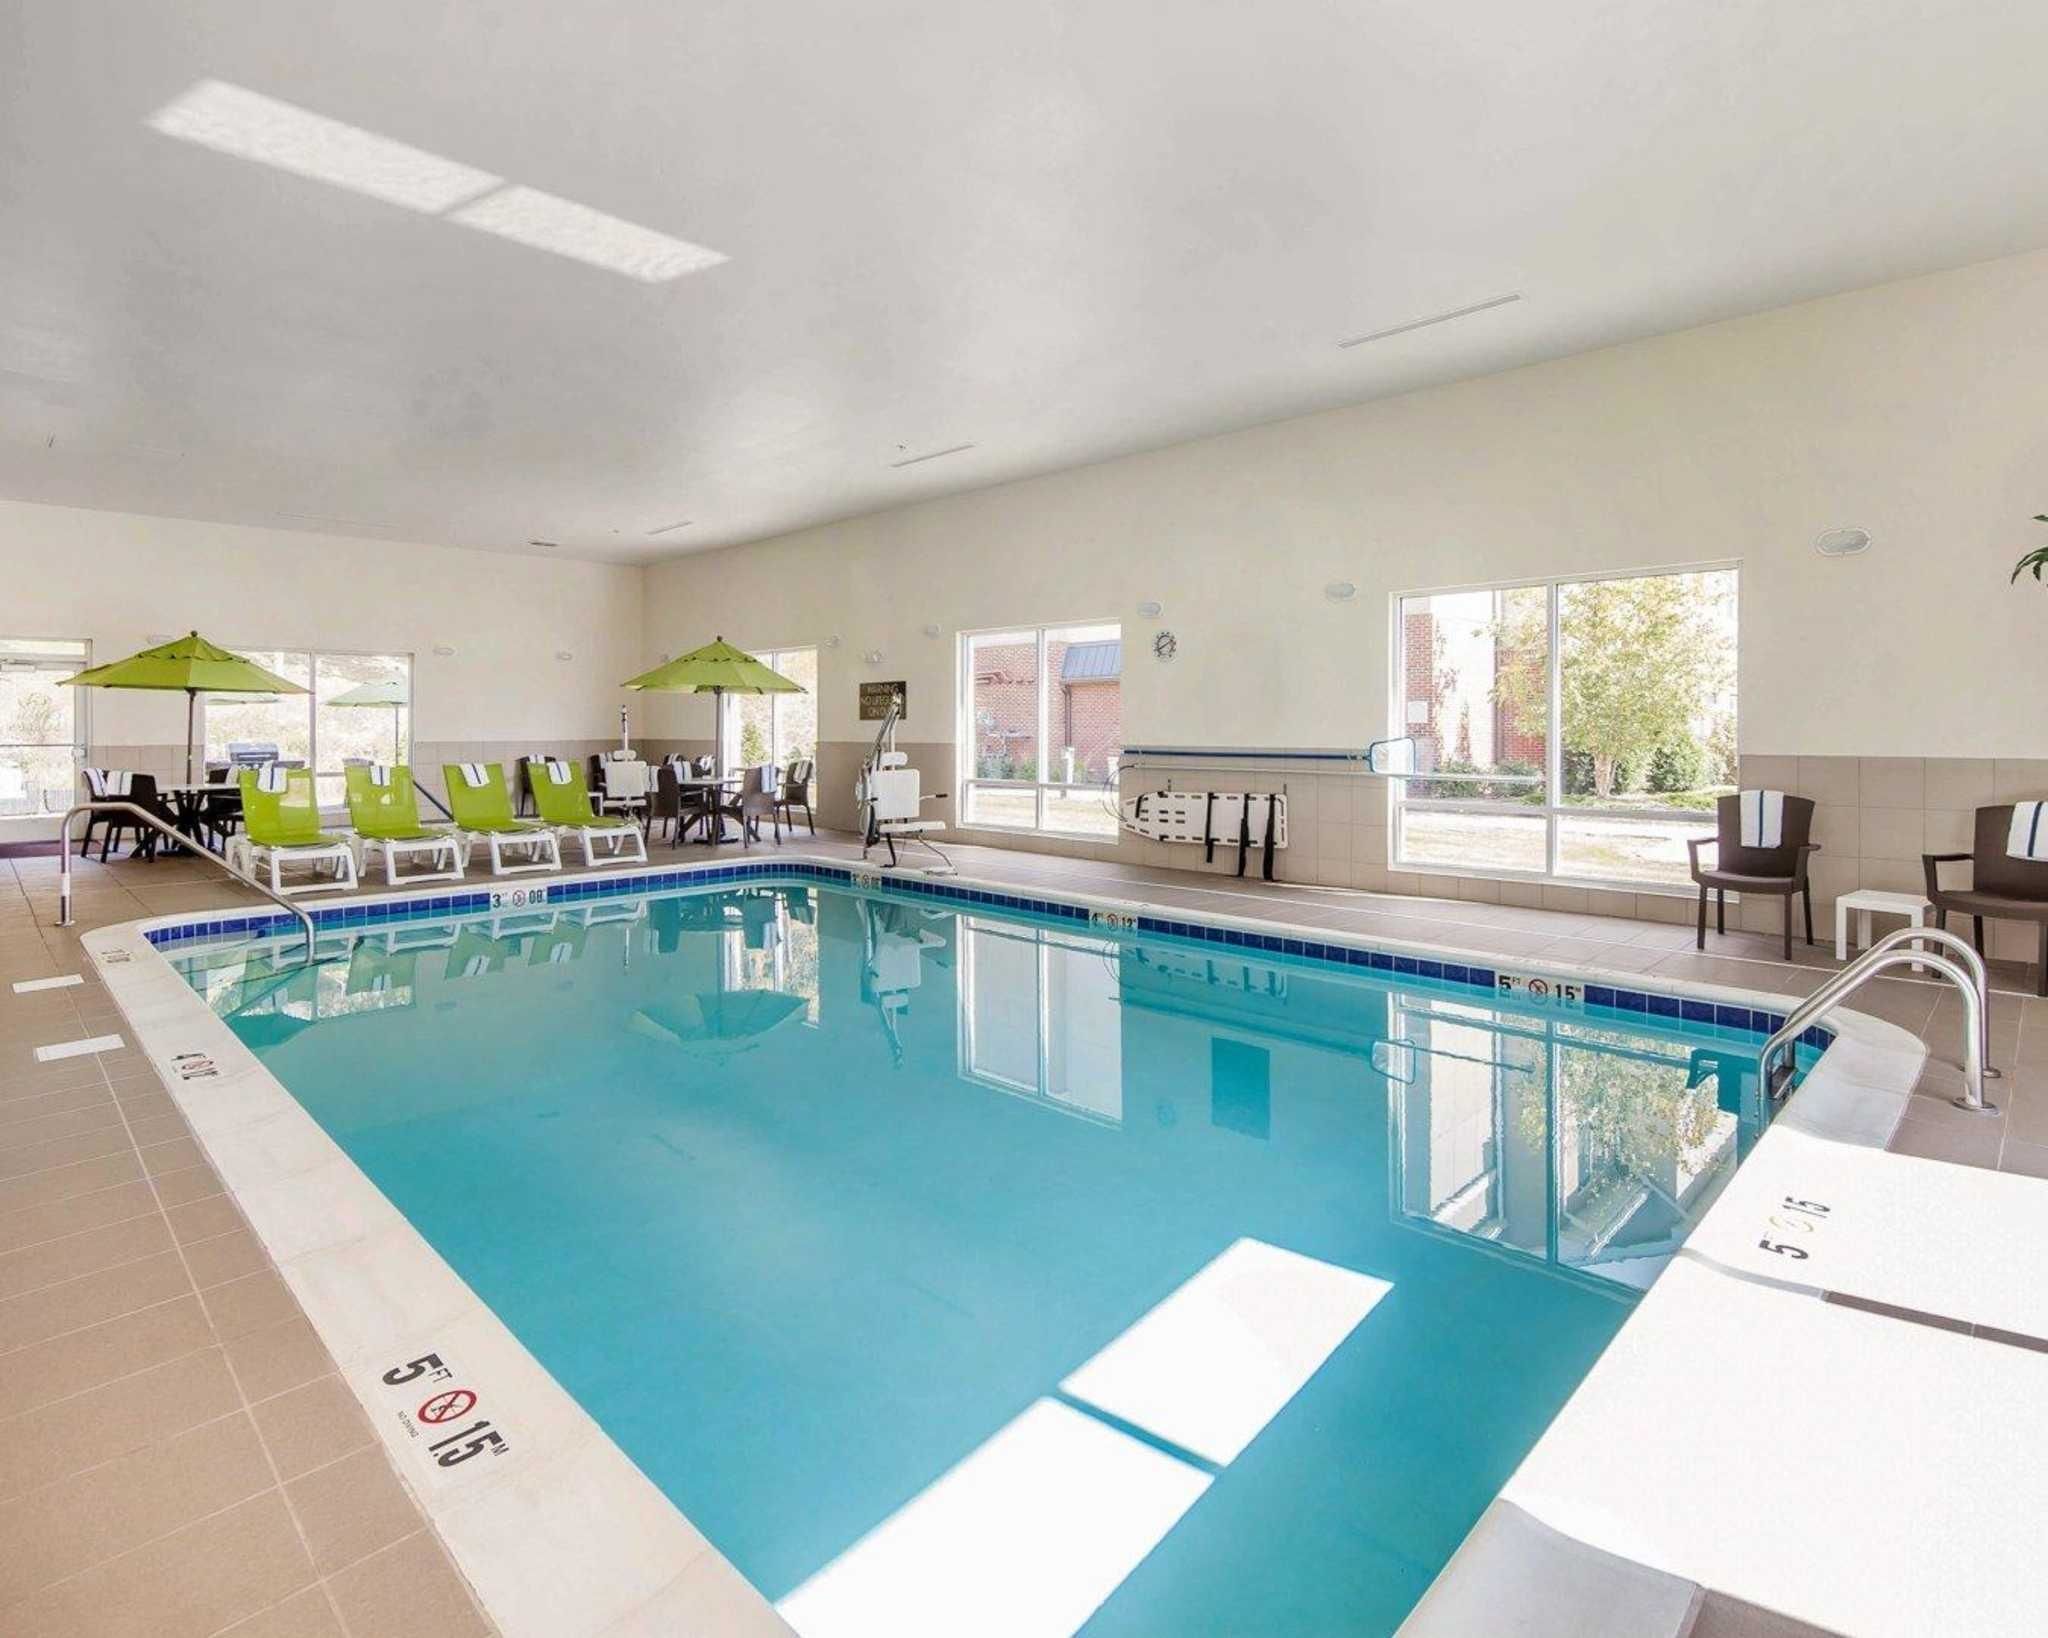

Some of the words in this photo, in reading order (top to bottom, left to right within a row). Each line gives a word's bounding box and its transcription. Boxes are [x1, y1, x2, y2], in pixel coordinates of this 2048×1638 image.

[860, 695, 871, 705] NO
[492, 894, 501, 909] 3
[1758, 1239, 1809, 1260] 5
